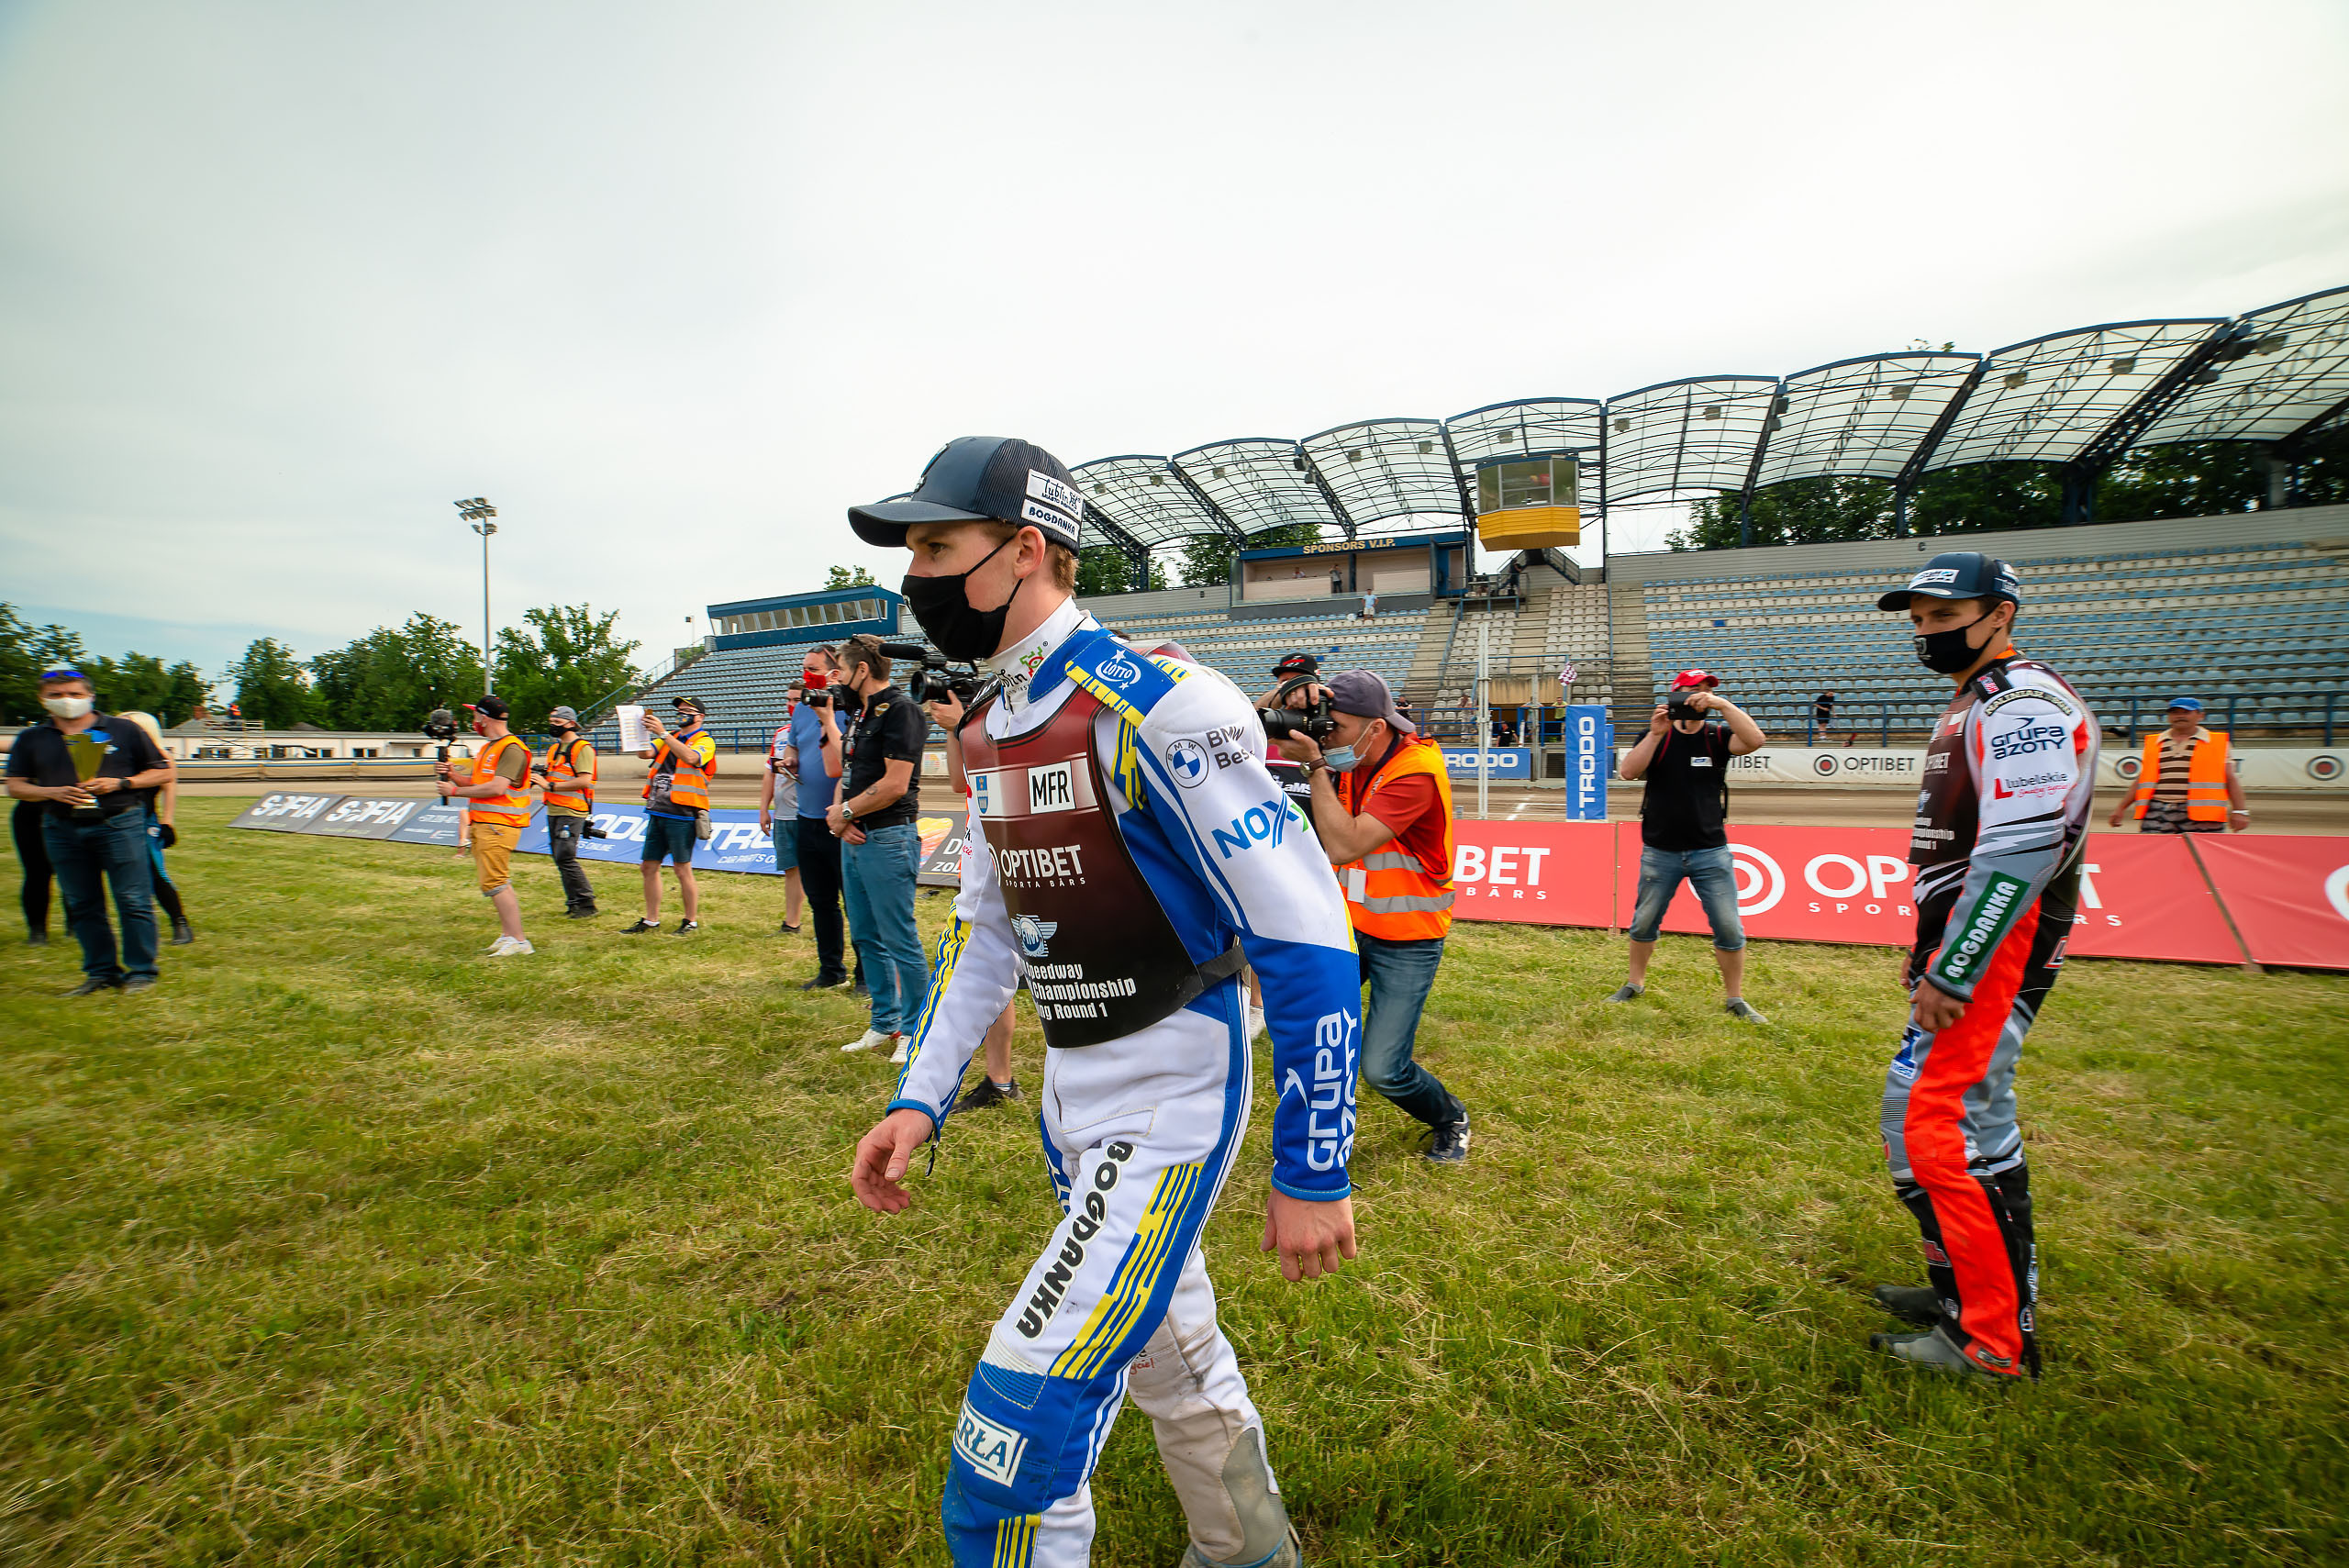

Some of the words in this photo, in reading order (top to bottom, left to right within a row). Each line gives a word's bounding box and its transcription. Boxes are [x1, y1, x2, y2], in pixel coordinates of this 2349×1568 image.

[1029, 506, 1075, 535] BOGDANKA
[1303, 539, 1366, 554] SPONSORS
[1369, 538, 1396, 549] V.I.P.
[1102, 662, 1133, 678] LOTTO
[1206, 726, 1244, 749] BMW
[1167, 741, 1197, 762] BMW
[1578, 716, 1596, 808] TRODO
[1844, 756, 1915, 772] OPTIBET
[1031, 770, 1070, 807] MFR
[1000, 844, 1083, 878] OPTIBET
[1452, 844, 1551, 886] BET
[1005, 879, 1041, 889] SPORTA
[1049, 876, 1085, 888] BĀRS
[1465, 885, 1548, 900] BĀRS
[1944, 881, 2020, 979] BOGDANKA
[1025, 961, 1084, 981] Speedway
[1032, 977, 1137, 1002] Championship
[1053, 1002, 1097, 1019] Round
[1098, 1002, 1108, 1018] 1
[1015, 1140, 1135, 1340] BOGDANKA
